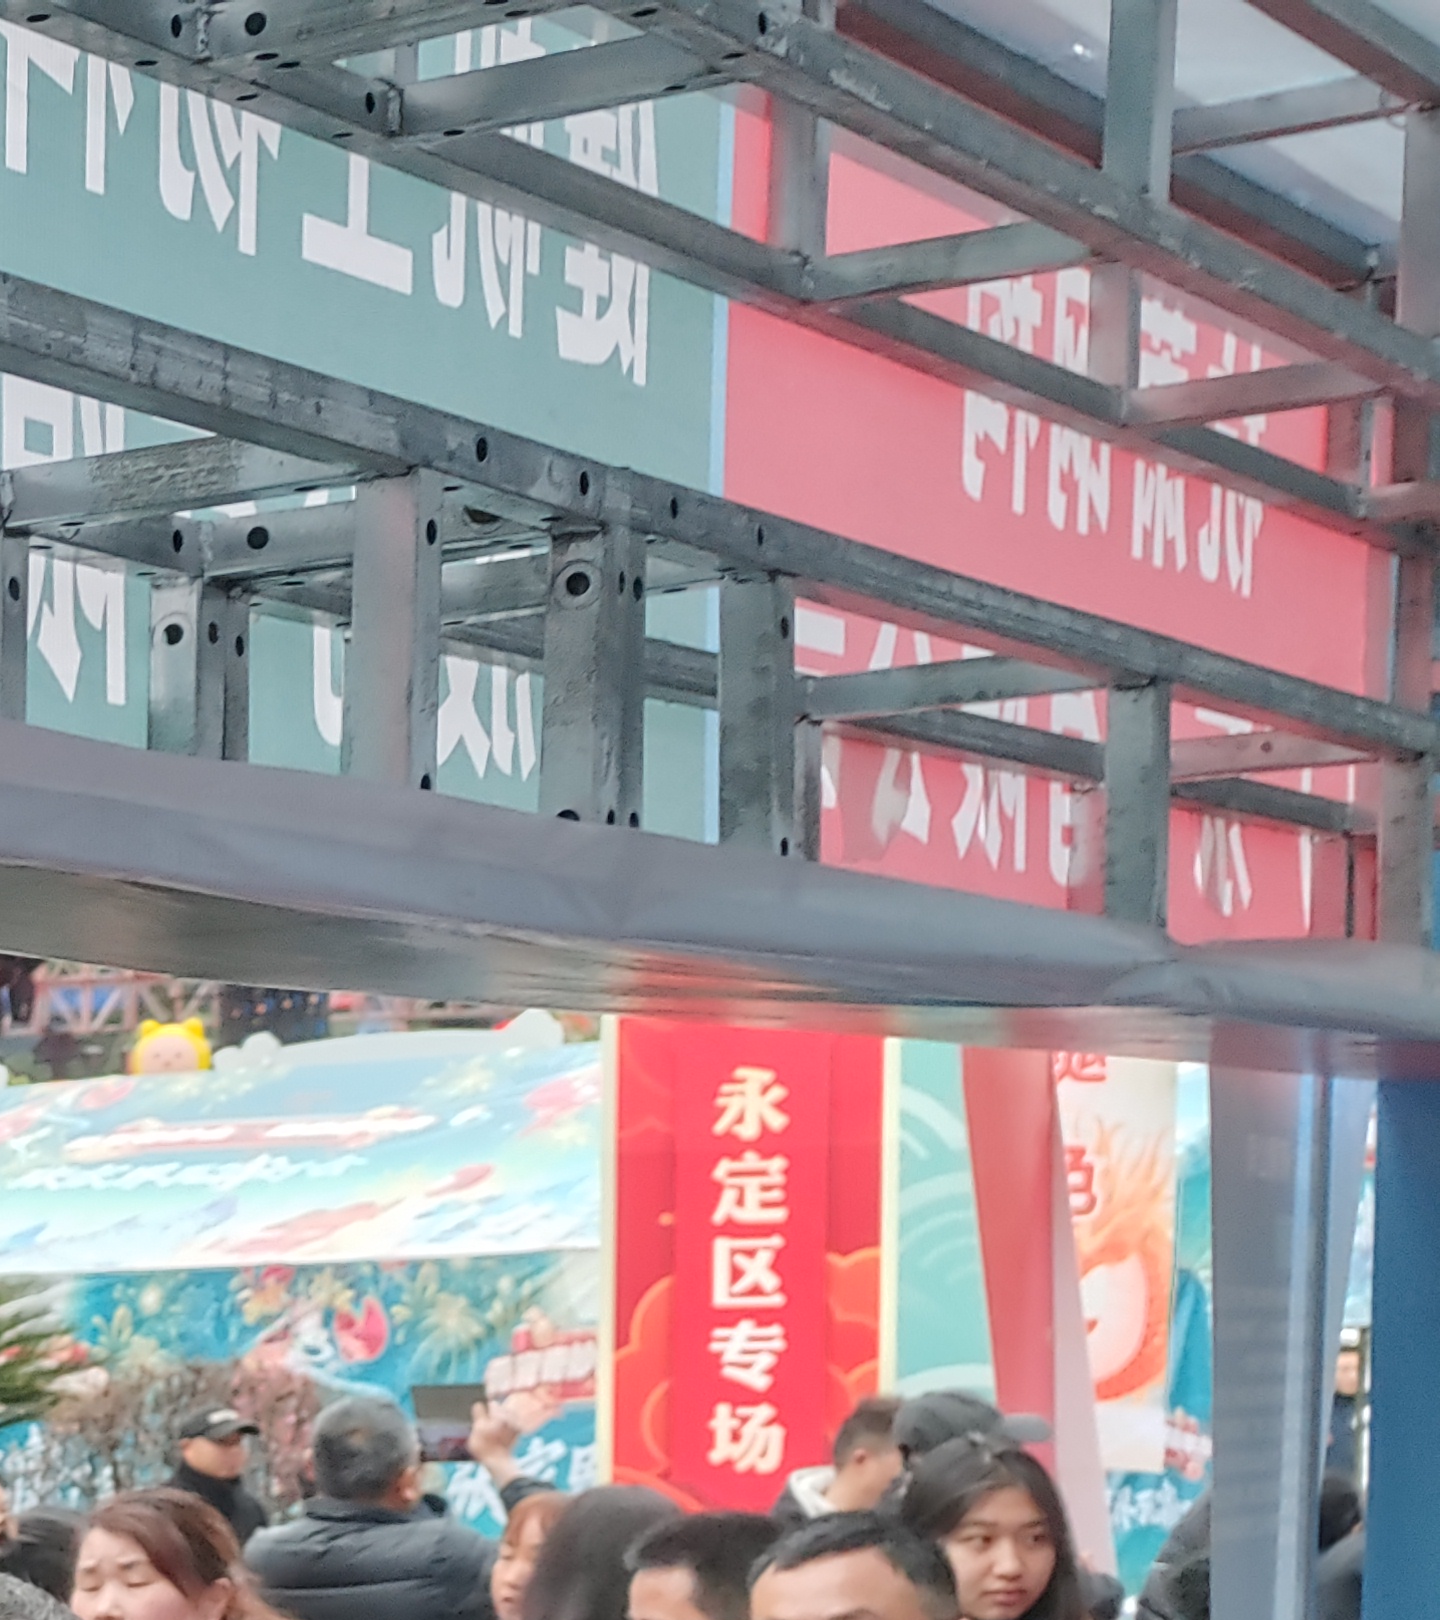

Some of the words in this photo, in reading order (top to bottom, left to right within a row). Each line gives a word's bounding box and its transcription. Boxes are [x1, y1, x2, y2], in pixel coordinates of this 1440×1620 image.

[708, 1064, 790, 1475] 永定区专场
